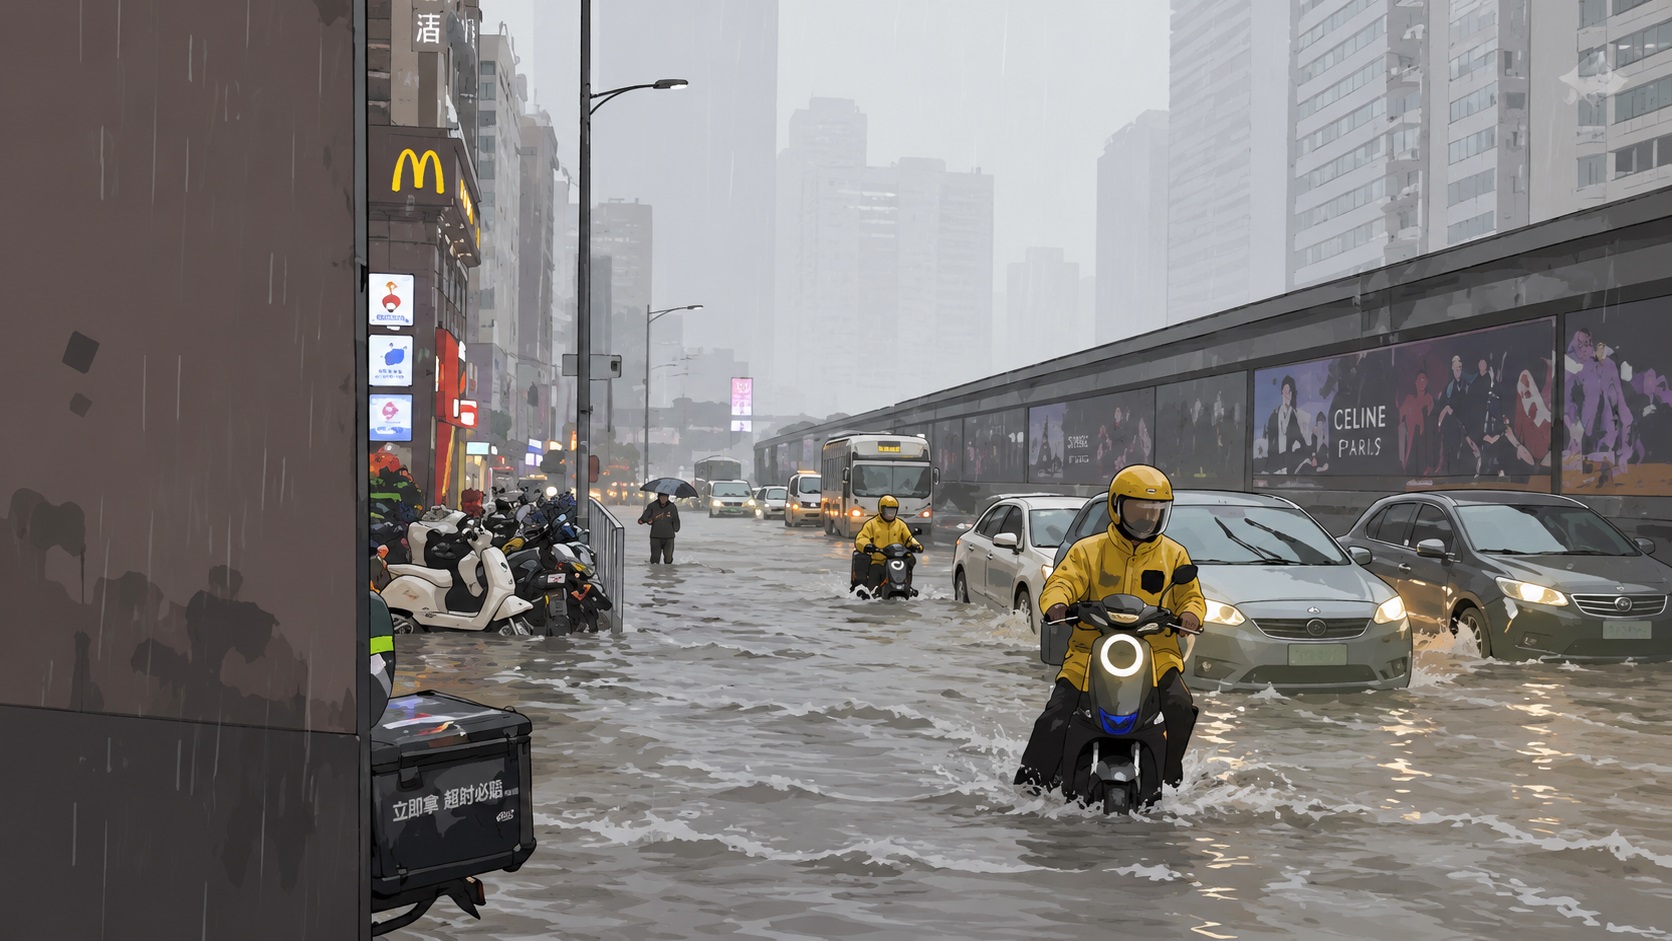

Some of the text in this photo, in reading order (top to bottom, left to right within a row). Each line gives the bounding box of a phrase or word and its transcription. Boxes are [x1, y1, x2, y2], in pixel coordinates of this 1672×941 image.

[391, 147, 445, 195] M
[1334, 405, 1386, 430] CELINE
[1338, 437, 1382, 458] PARIS
[392, 794, 439, 822] 立即拿
